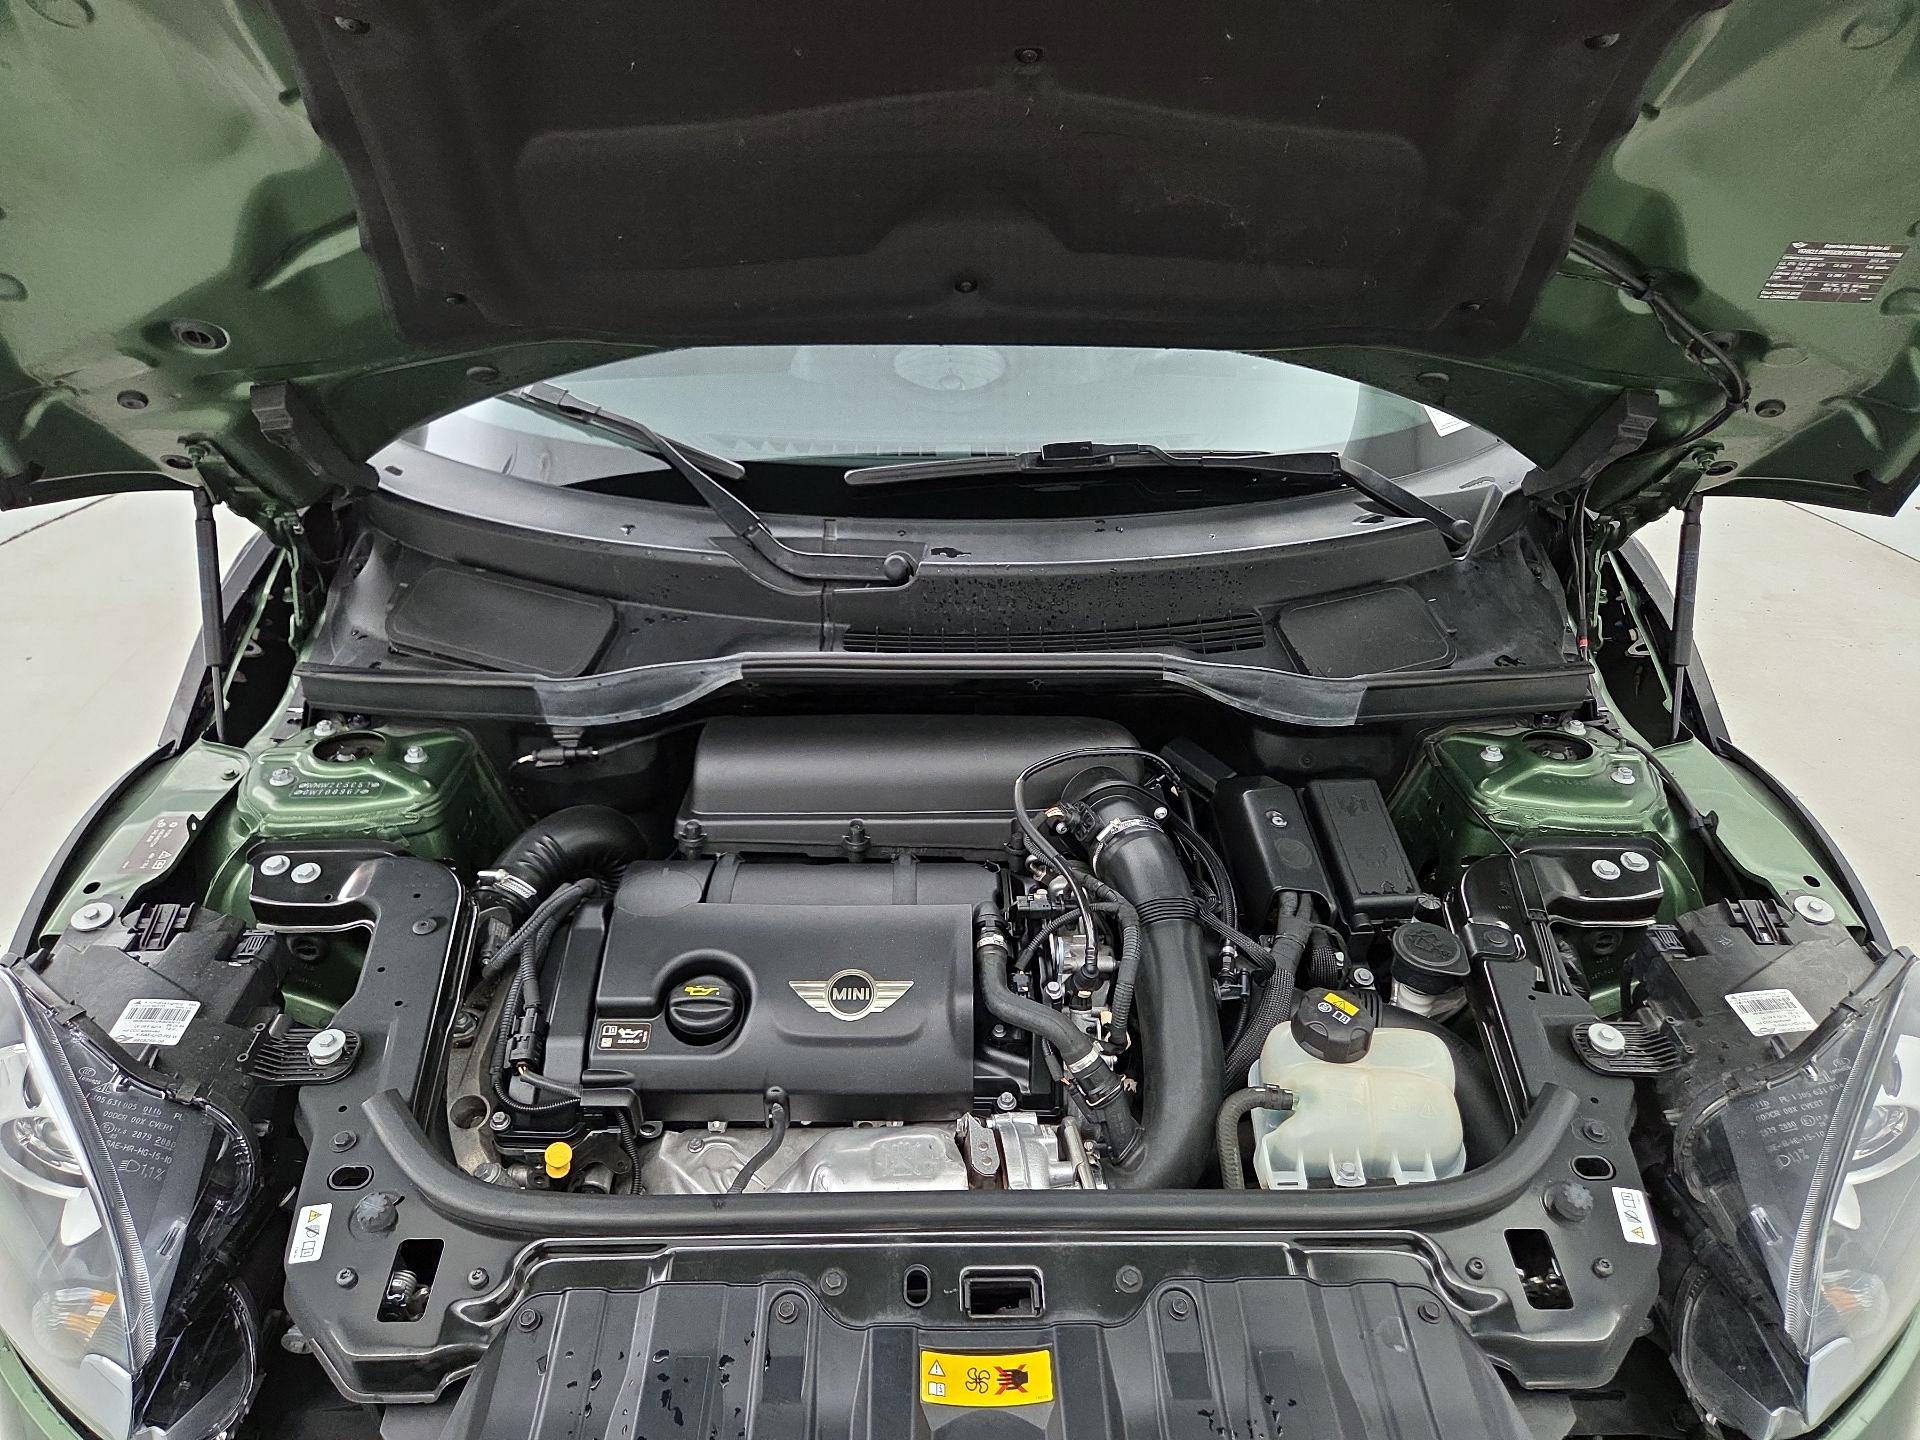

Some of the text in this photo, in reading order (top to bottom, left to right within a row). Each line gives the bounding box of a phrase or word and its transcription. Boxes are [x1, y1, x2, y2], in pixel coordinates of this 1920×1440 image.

[832, 987, 871, 1001] MINI
[173, 1112, 183, 1121] PL
[148, 1120, 175, 1132] CVERT
[131, 1130, 153, 1141] 2879
